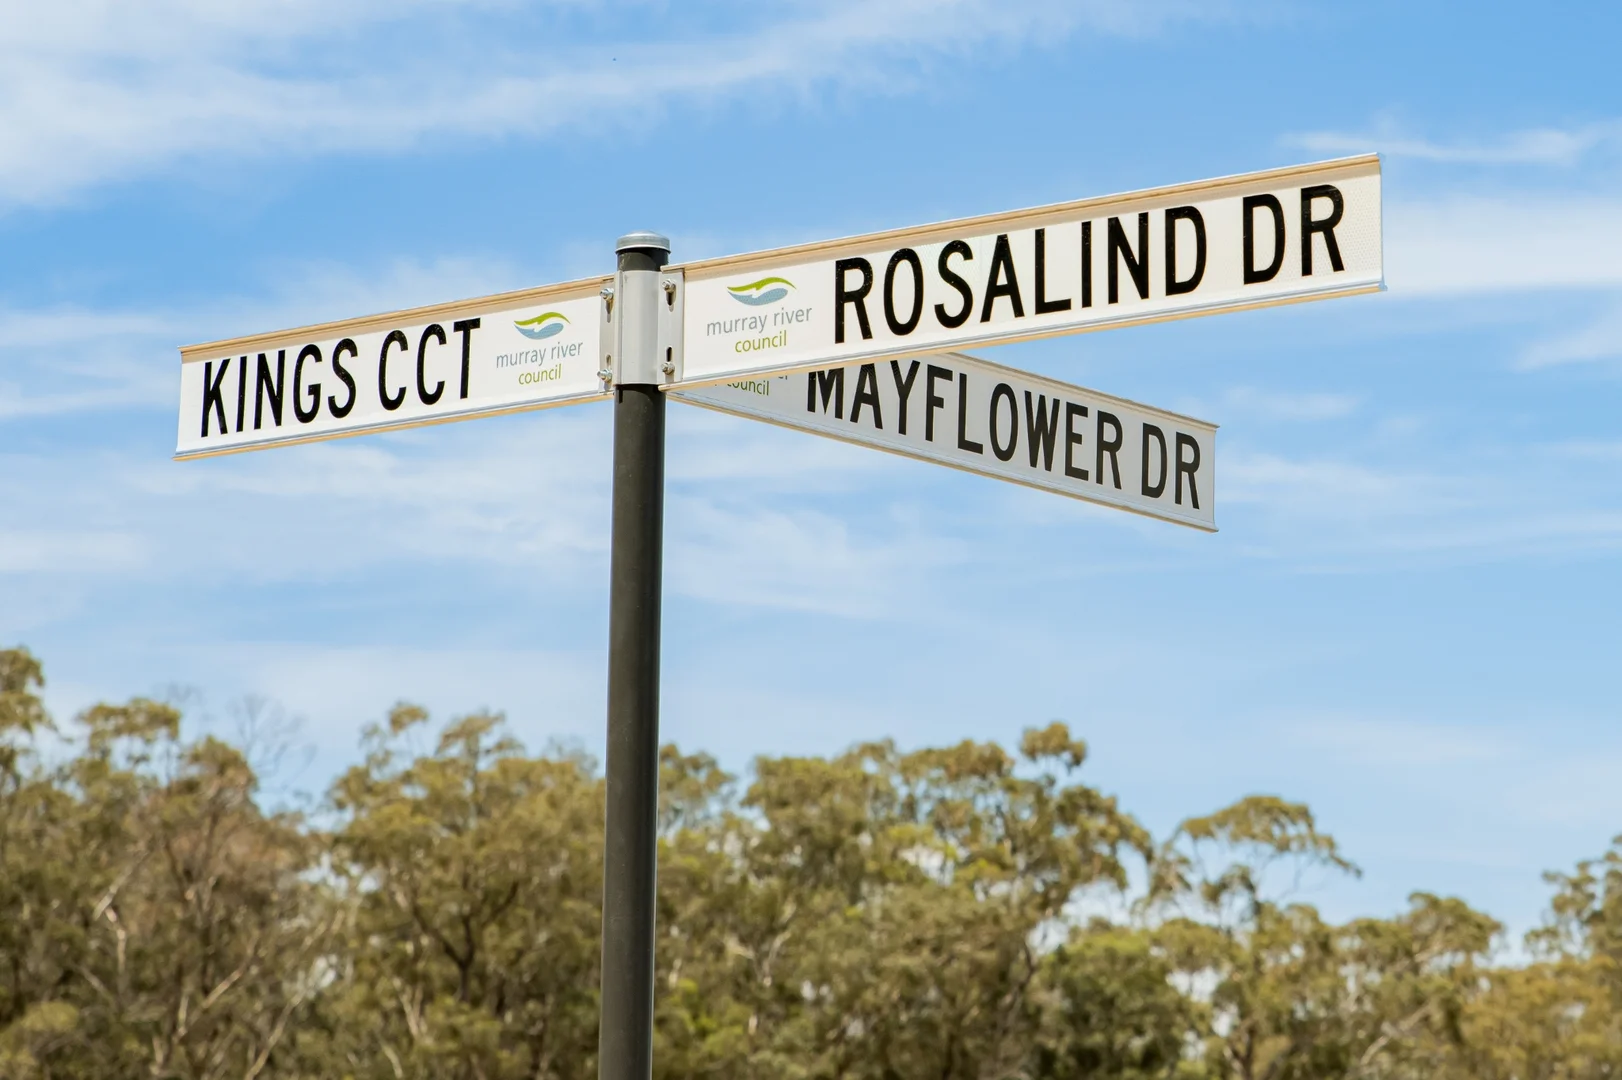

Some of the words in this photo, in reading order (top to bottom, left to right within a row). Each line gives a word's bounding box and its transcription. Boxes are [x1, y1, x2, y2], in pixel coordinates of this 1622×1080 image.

[834, 205, 1207, 344] ROSALIND
[1242, 184, 1345, 285] DR
[706, 314, 768, 336] murray
[773, 307, 813, 326] river
[496, 347, 546, 367] murray
[551, 342, 583, 360] river
[735, 330, 787, 353] council
[201, 338, 358, 438] KINGS
[378, 317, 481, 411] CCT
[518, 363, 562, 385] council
[727, 380, 769, 396] ouncil
[807, 359, 1123, 490] MAYFLOWER
[1141, 422, 1201, 510] DR
